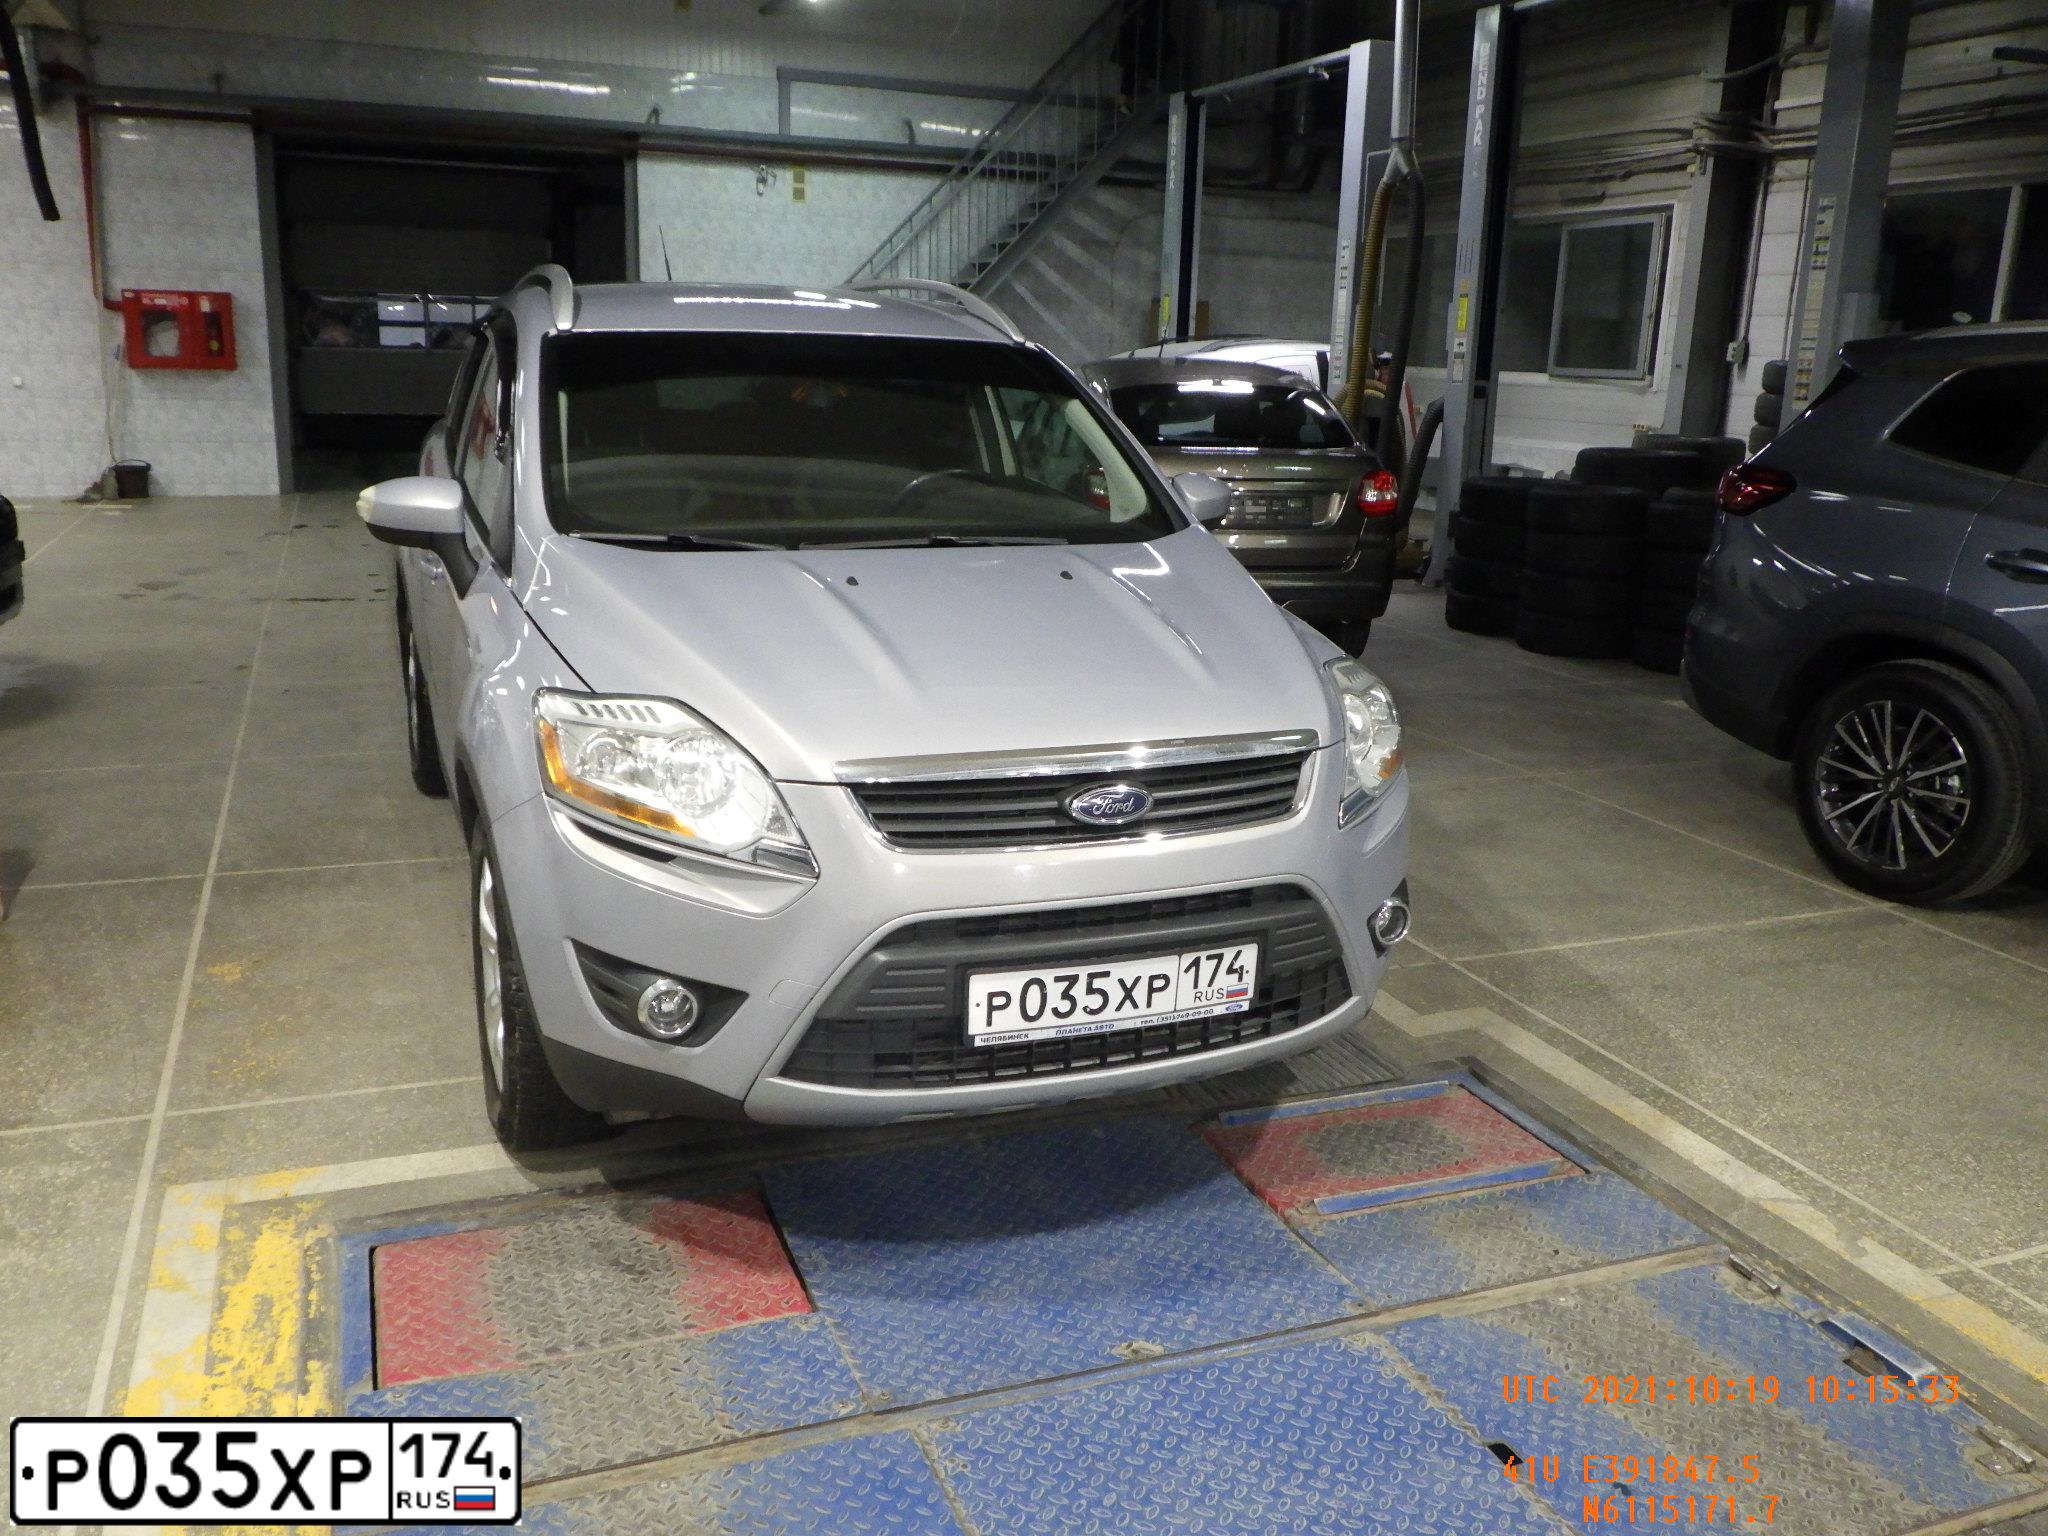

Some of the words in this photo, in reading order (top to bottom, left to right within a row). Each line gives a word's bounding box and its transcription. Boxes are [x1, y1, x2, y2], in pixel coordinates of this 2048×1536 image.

[1092, 792, 1134, 815] Ford
[1183, 949, 1244, 990] 174
[1193, 986, 1225, 1003] RUS
[980, 1033, 1029, 1044] ЧЕЛЯБИНСК
[1055, 1026, 1092, 1036] ПЛАНЕТА
[1093, 1023, 1115, 1032] АВТО
